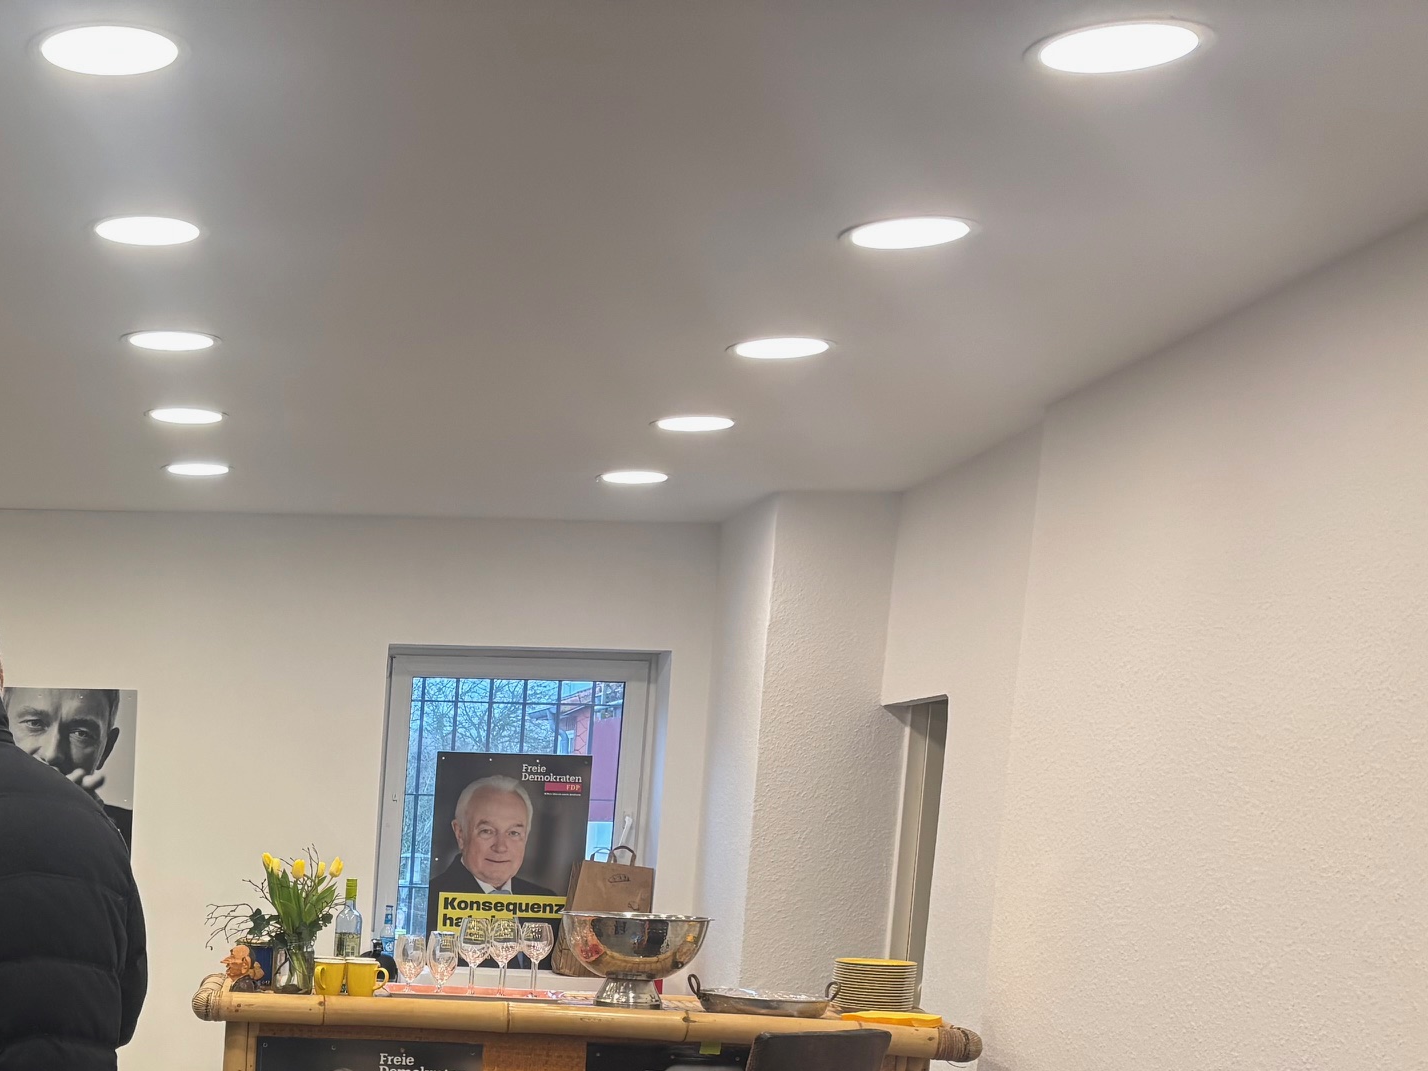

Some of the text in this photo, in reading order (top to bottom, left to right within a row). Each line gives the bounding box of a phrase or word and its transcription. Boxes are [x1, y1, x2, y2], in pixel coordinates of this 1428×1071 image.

[522, 763, 547, 773] Freie
[521, 772, 582, 783] Demokraten
[443, 896, 566, 915] Konsequenz
[379, 1053, 414, 1065] Freie
